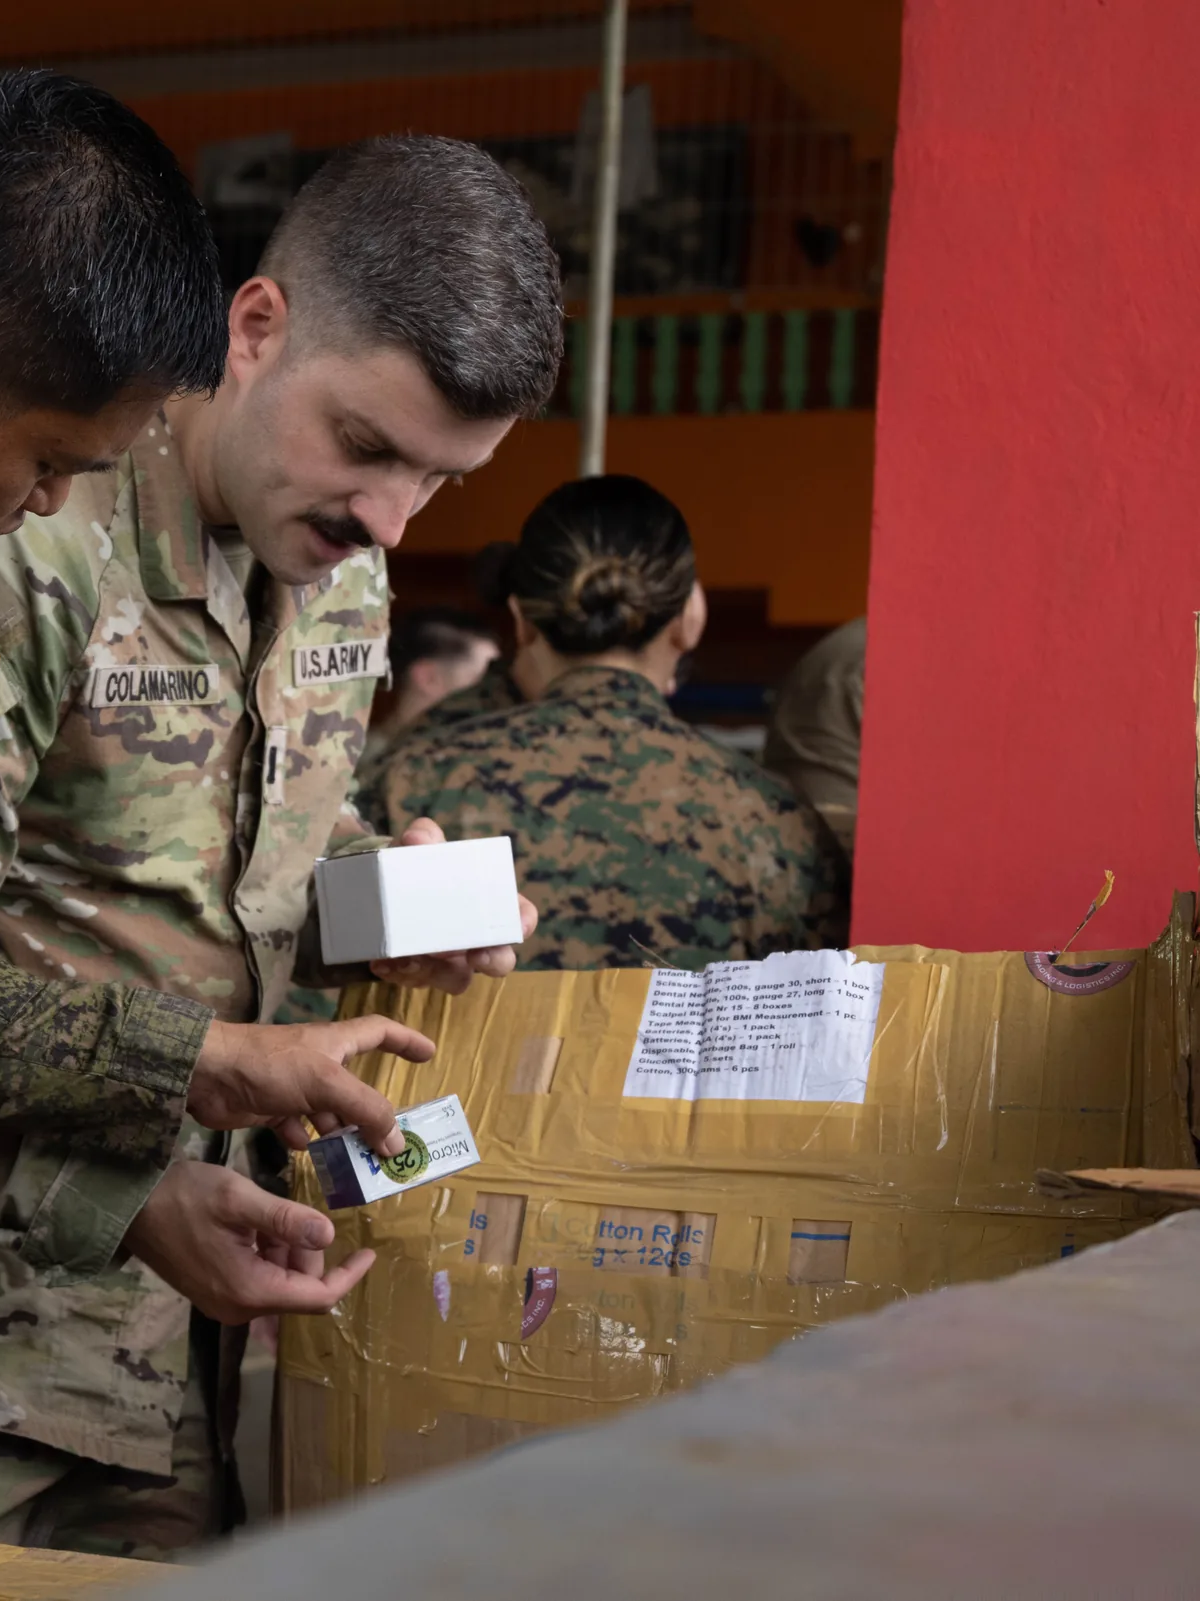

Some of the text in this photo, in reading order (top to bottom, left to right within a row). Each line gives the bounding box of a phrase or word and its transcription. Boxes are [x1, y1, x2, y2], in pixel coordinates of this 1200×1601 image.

[105, 669, 209, 702] COLAMARINO
[722, 965, 730, 973] 2
[732, 965, 750, 973] pcs
[1032, 954, 1057, 984] TRADING
[1064, 976, 1111, 990] LOGISTICS
[715, 976, 732, 984] pcs
[653, 990, 686, 998] Dental
[726, 984, 751, 992] 100s,
[754, 982, 785, 991] gauge
[788, 979, 802, 988] 30,
[805, 976, 831, 986] short
[851, 981, 871, 991] box
[652, 1000, 685, 1008] Dental
[723, 994, 750, 1002] 100s,
[752, 993, 783, 1001] gauge
[804, 988, 825, 997] long
[845, 991, 865, 1000] box
[649, 1010, 686, 1018] Scalpel
[762, 1002, 793, 1010] boxes
[754, 1010, 824, 1020] Measurement
[750, 1023, 776, 1031] pack
[643, 1037, 691, 1045] Batteries,
[755, 1033, 781, 1041] pack
[641, 1047, 695, 1055] Disposable
[638, 1057, 697, 1065] Glucometer
[636, 1067, 673, 1075] Cotton,
[741, 1065, 759, 1074] pcs
[393, 1148, 416, 1173] 25
